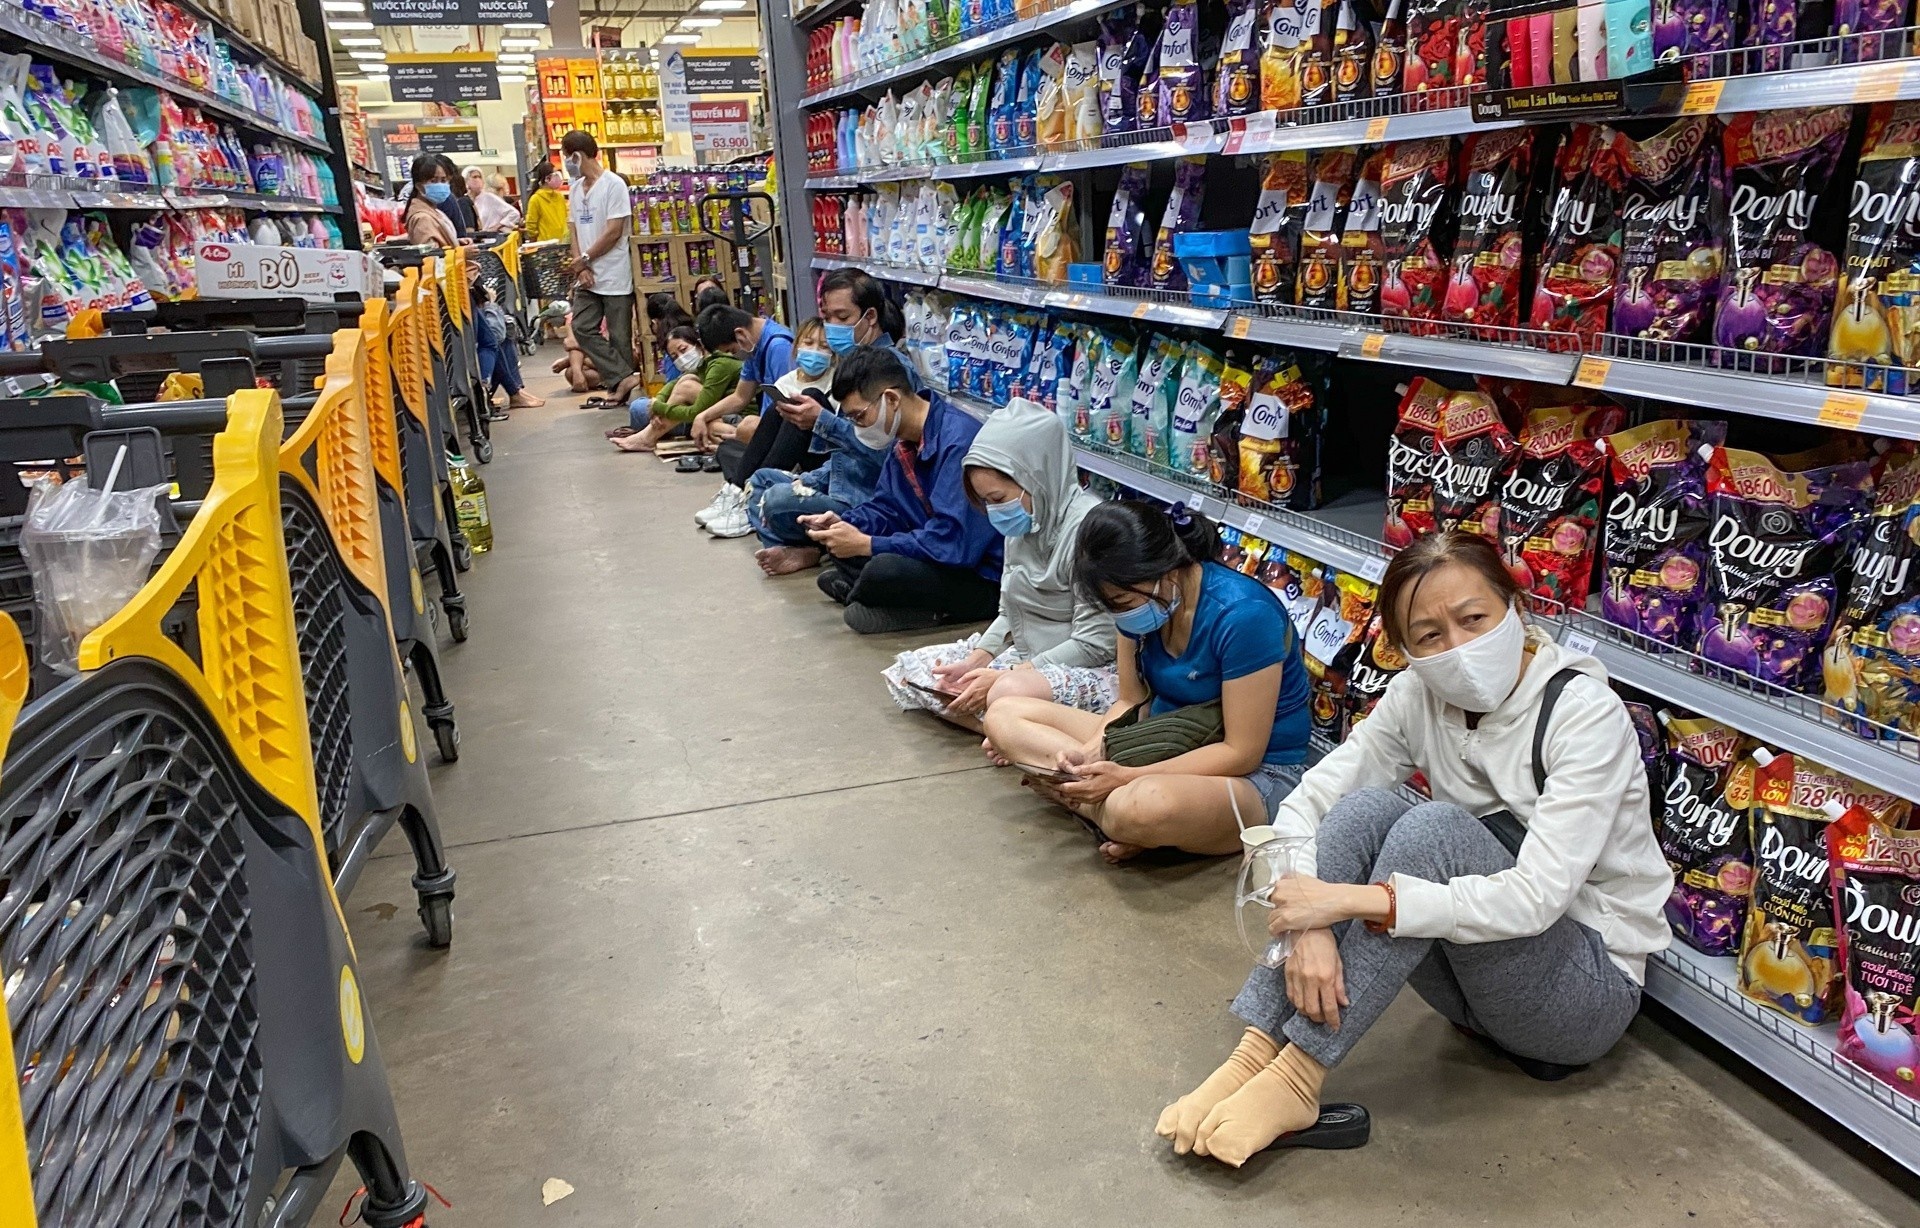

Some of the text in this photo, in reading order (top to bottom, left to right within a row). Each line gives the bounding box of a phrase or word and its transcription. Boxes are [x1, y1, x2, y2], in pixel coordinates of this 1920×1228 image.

[692, 106, 741, 119] KHUYẾN MÃI
[712, 137, 749, 148] 63.900
[259, 250, 299, 290] BÒ
[1431, 455, 1493, 497] Downy
[1313, 619, 1345, 648] Comfort
[1762, 788, 1788, 802] LỚN
[1790, 911, 1815, 929] HÚT
[1860, 970, 1914, 996] TƯƠI TRẺ
